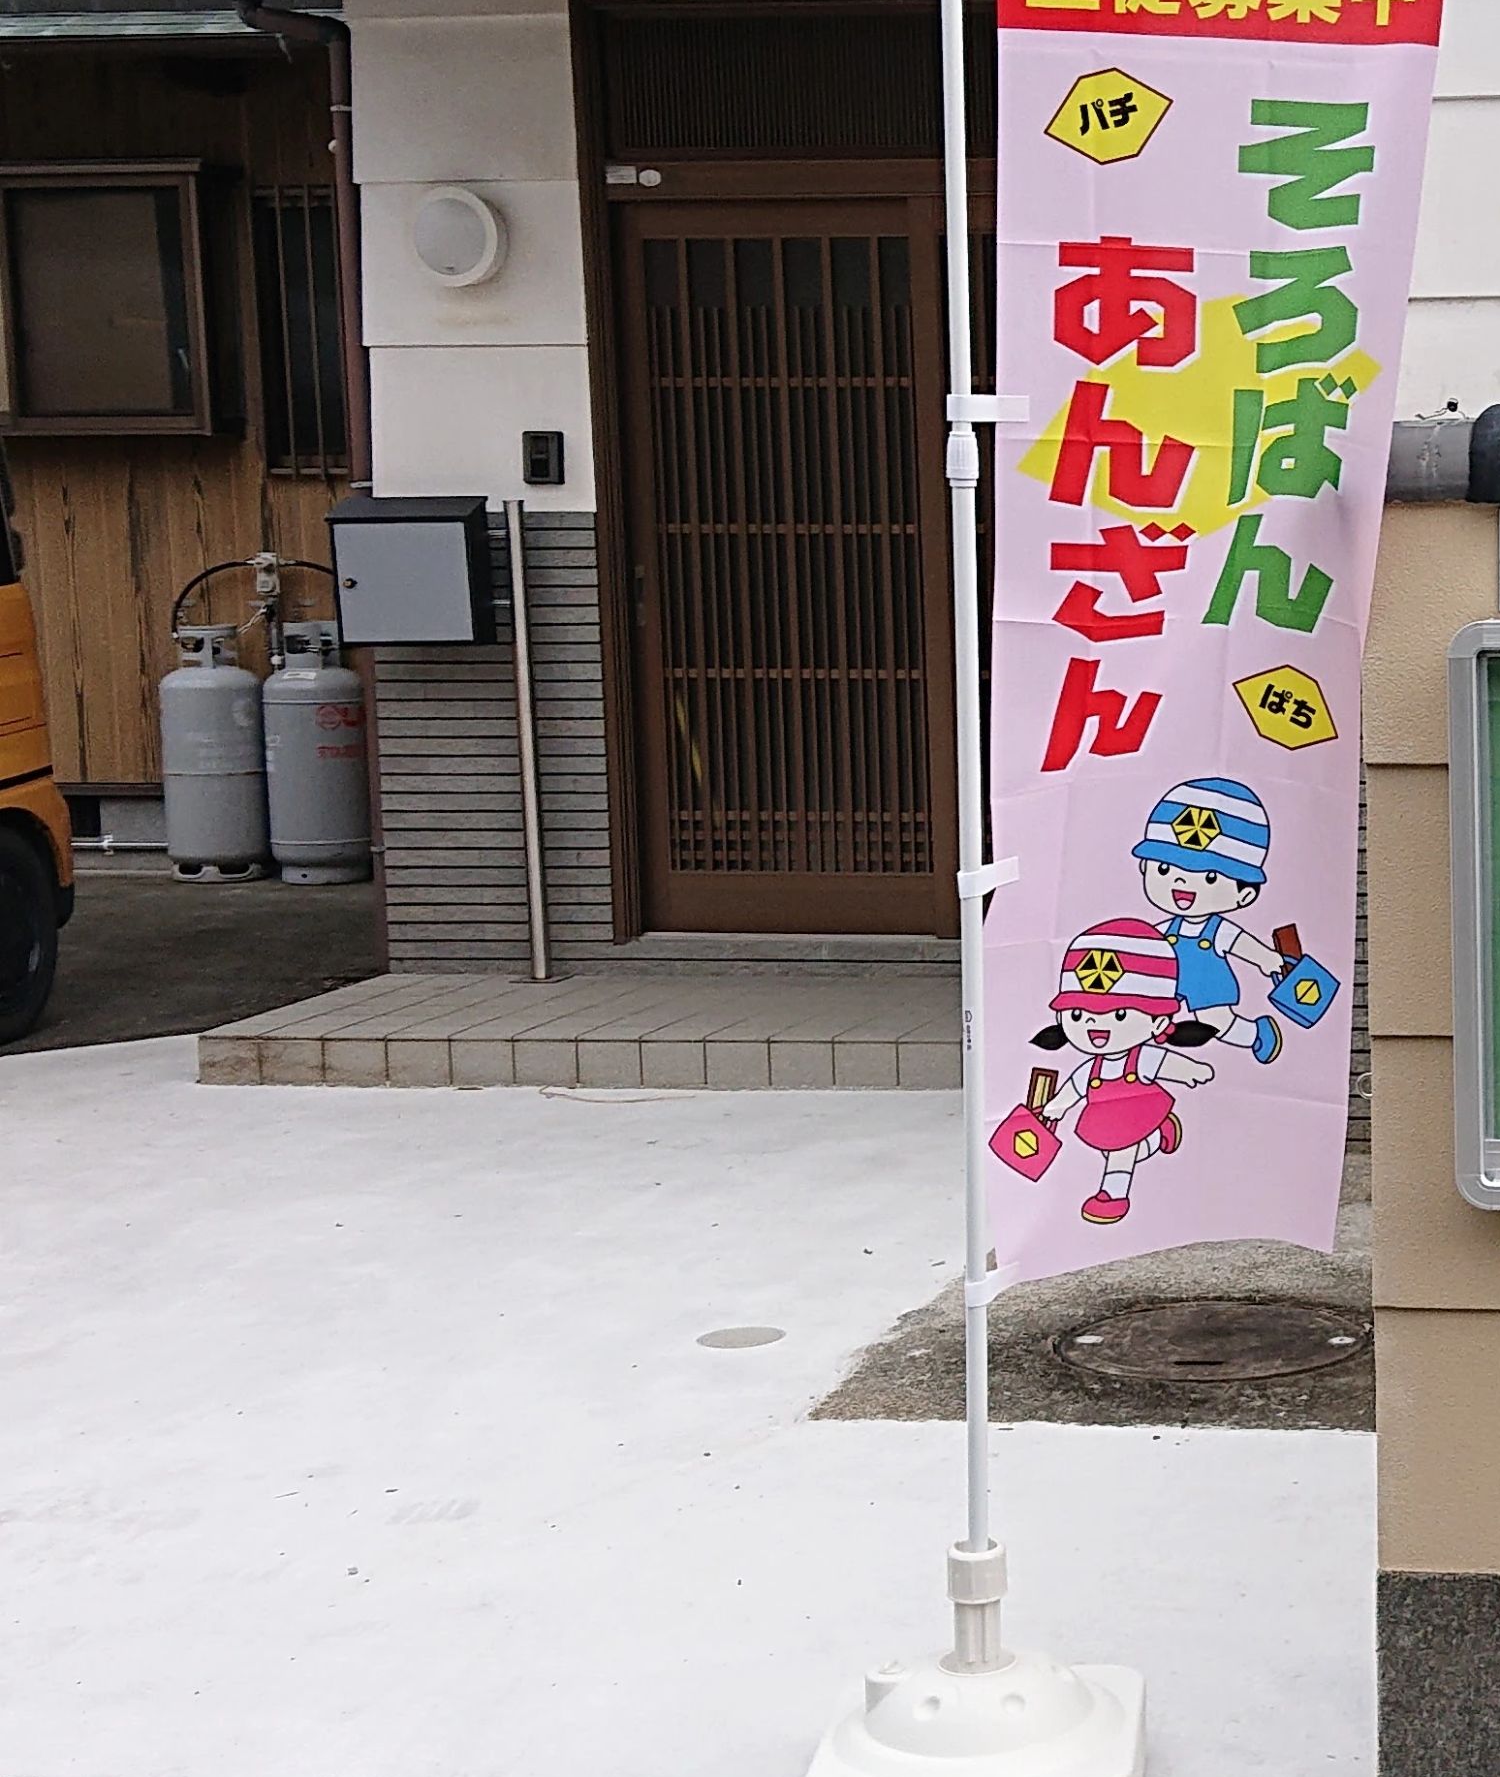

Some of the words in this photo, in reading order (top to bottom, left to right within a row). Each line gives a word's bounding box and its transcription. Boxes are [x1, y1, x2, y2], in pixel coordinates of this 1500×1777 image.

[1078, 92, 1138, 137] パチ
[1041, 236, 1196, 773] あんざん
[1203, 98, 1375, 633] そろばん
[1257, 681, 1318, 729] ぱち
